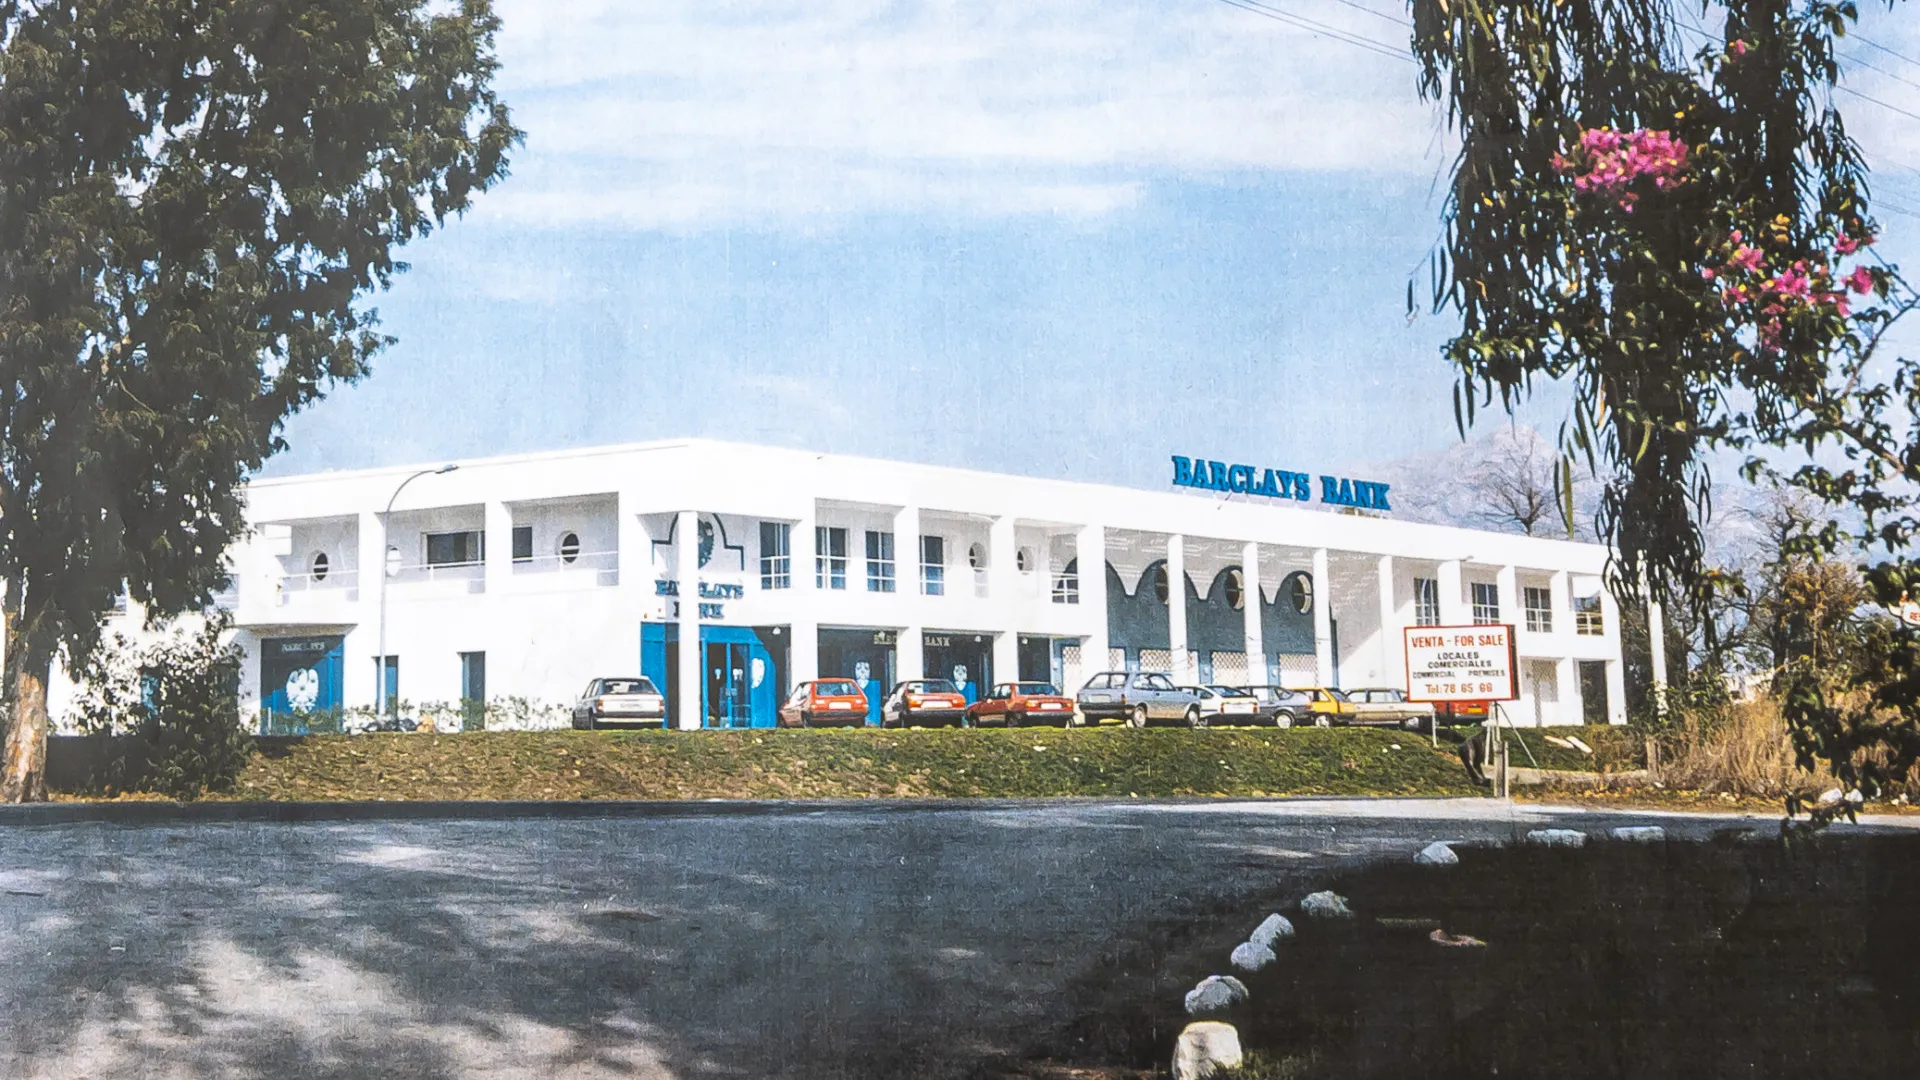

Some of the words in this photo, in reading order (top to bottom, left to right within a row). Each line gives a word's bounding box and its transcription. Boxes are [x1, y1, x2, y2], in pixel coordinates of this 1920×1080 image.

[1172, 455, 1310, 501] BARCLAYS
[1320, 475, 1391, 510] BANK
[1411, 636, 1444, 648] VENTA
[1454, 635, 1474, 646] FOR
[1478, 634, 1504, 646] SALE
[1437, 651, 1480, 660] LOCALES
[1427, 660, 1492, 669] COMERCIALES
[1461, 683, 1473, 693] 65
